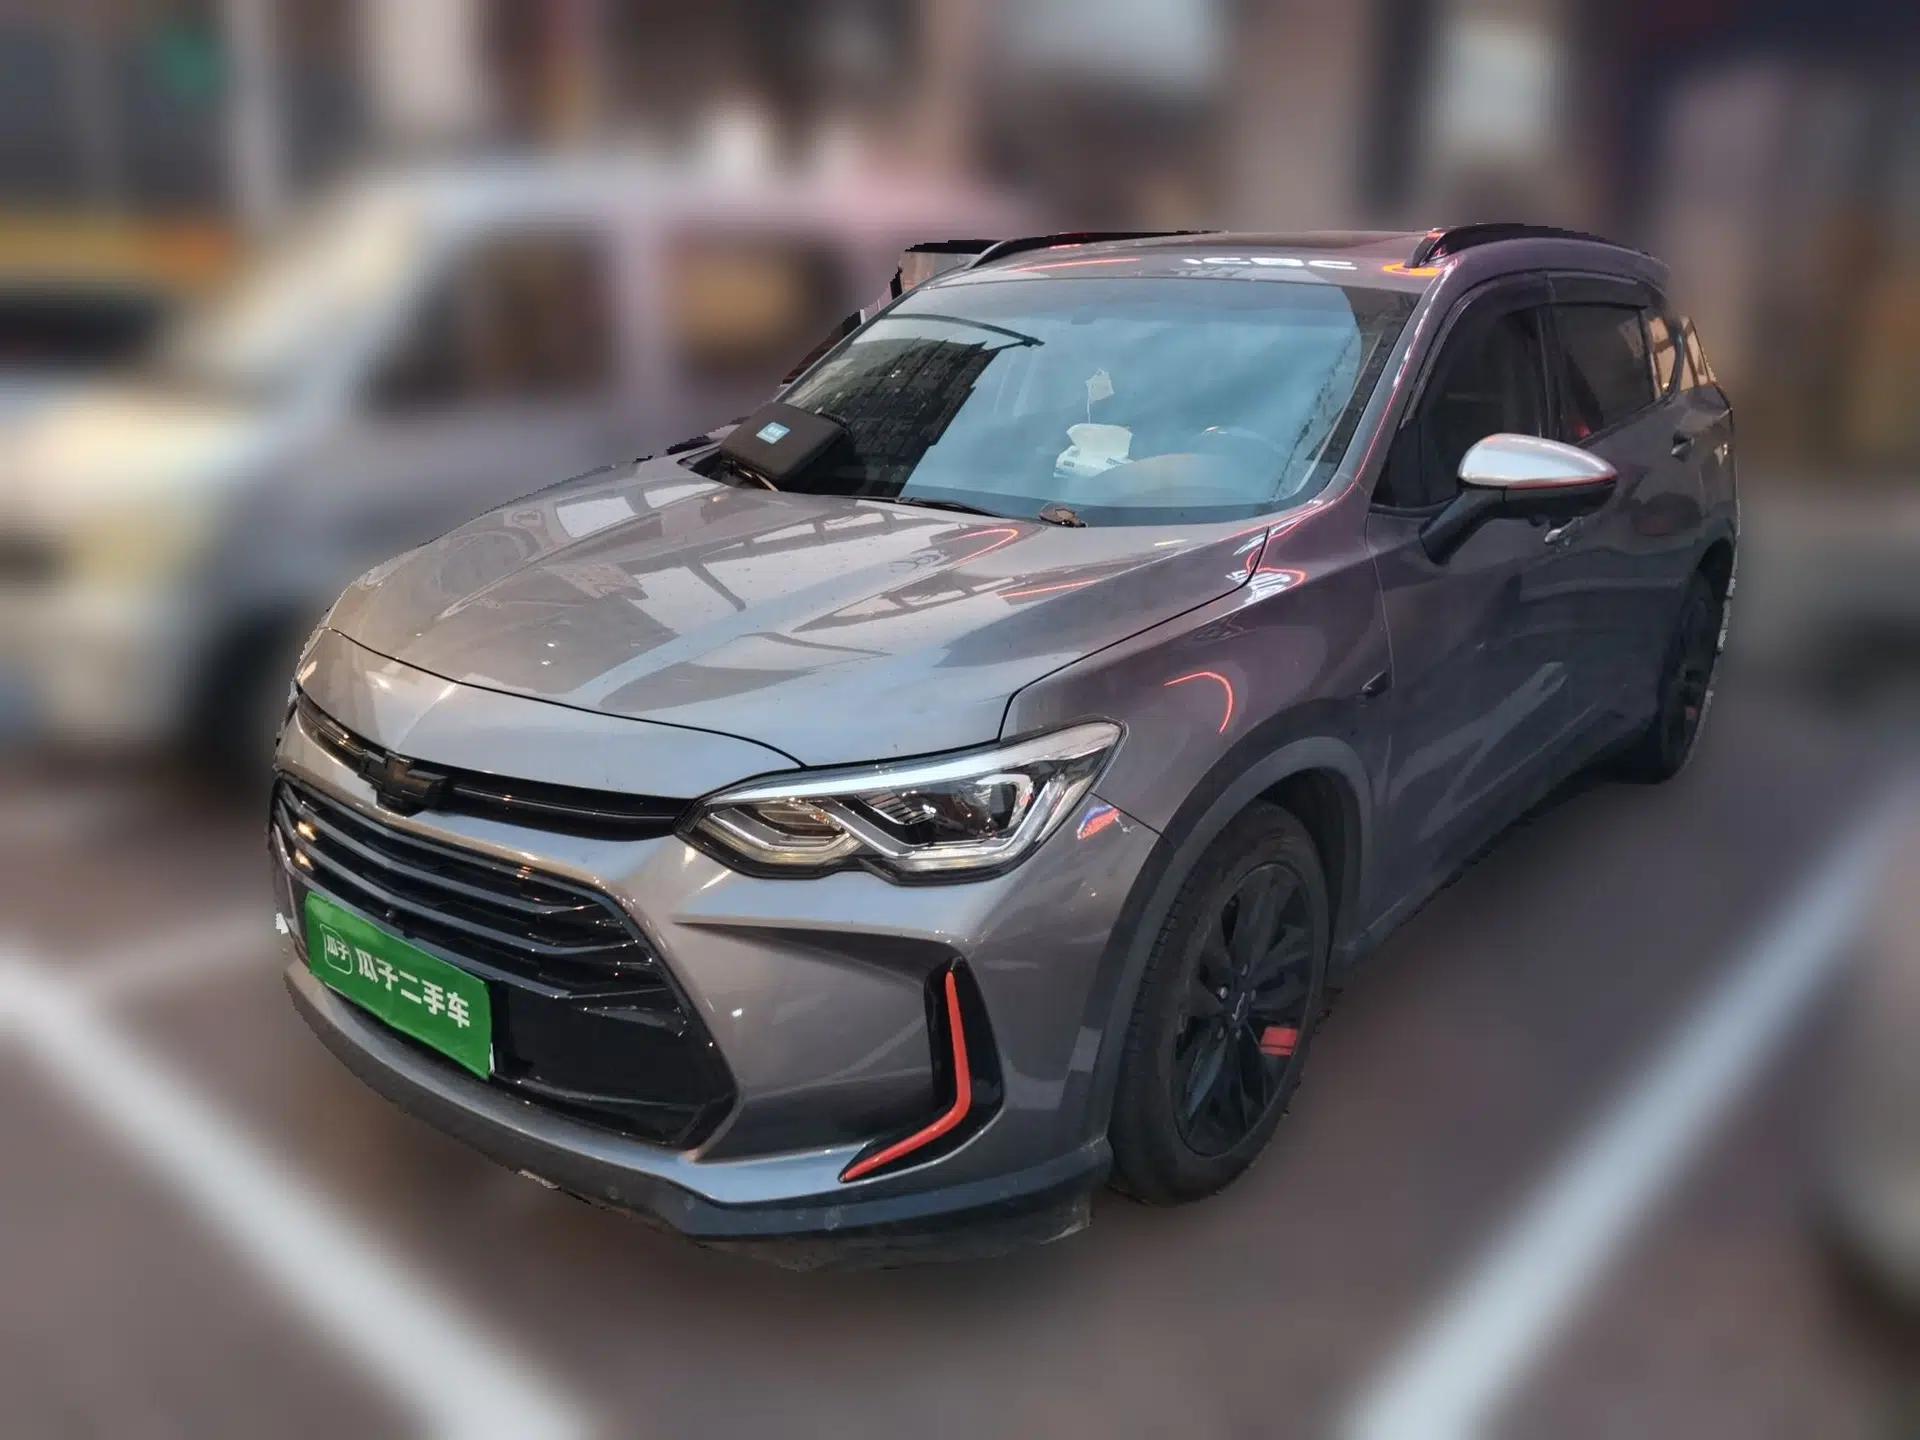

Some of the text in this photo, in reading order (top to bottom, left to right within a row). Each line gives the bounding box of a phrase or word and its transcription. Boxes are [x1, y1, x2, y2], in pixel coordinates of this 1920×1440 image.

[355, 948, 470, 1028] 瓜子二手车
